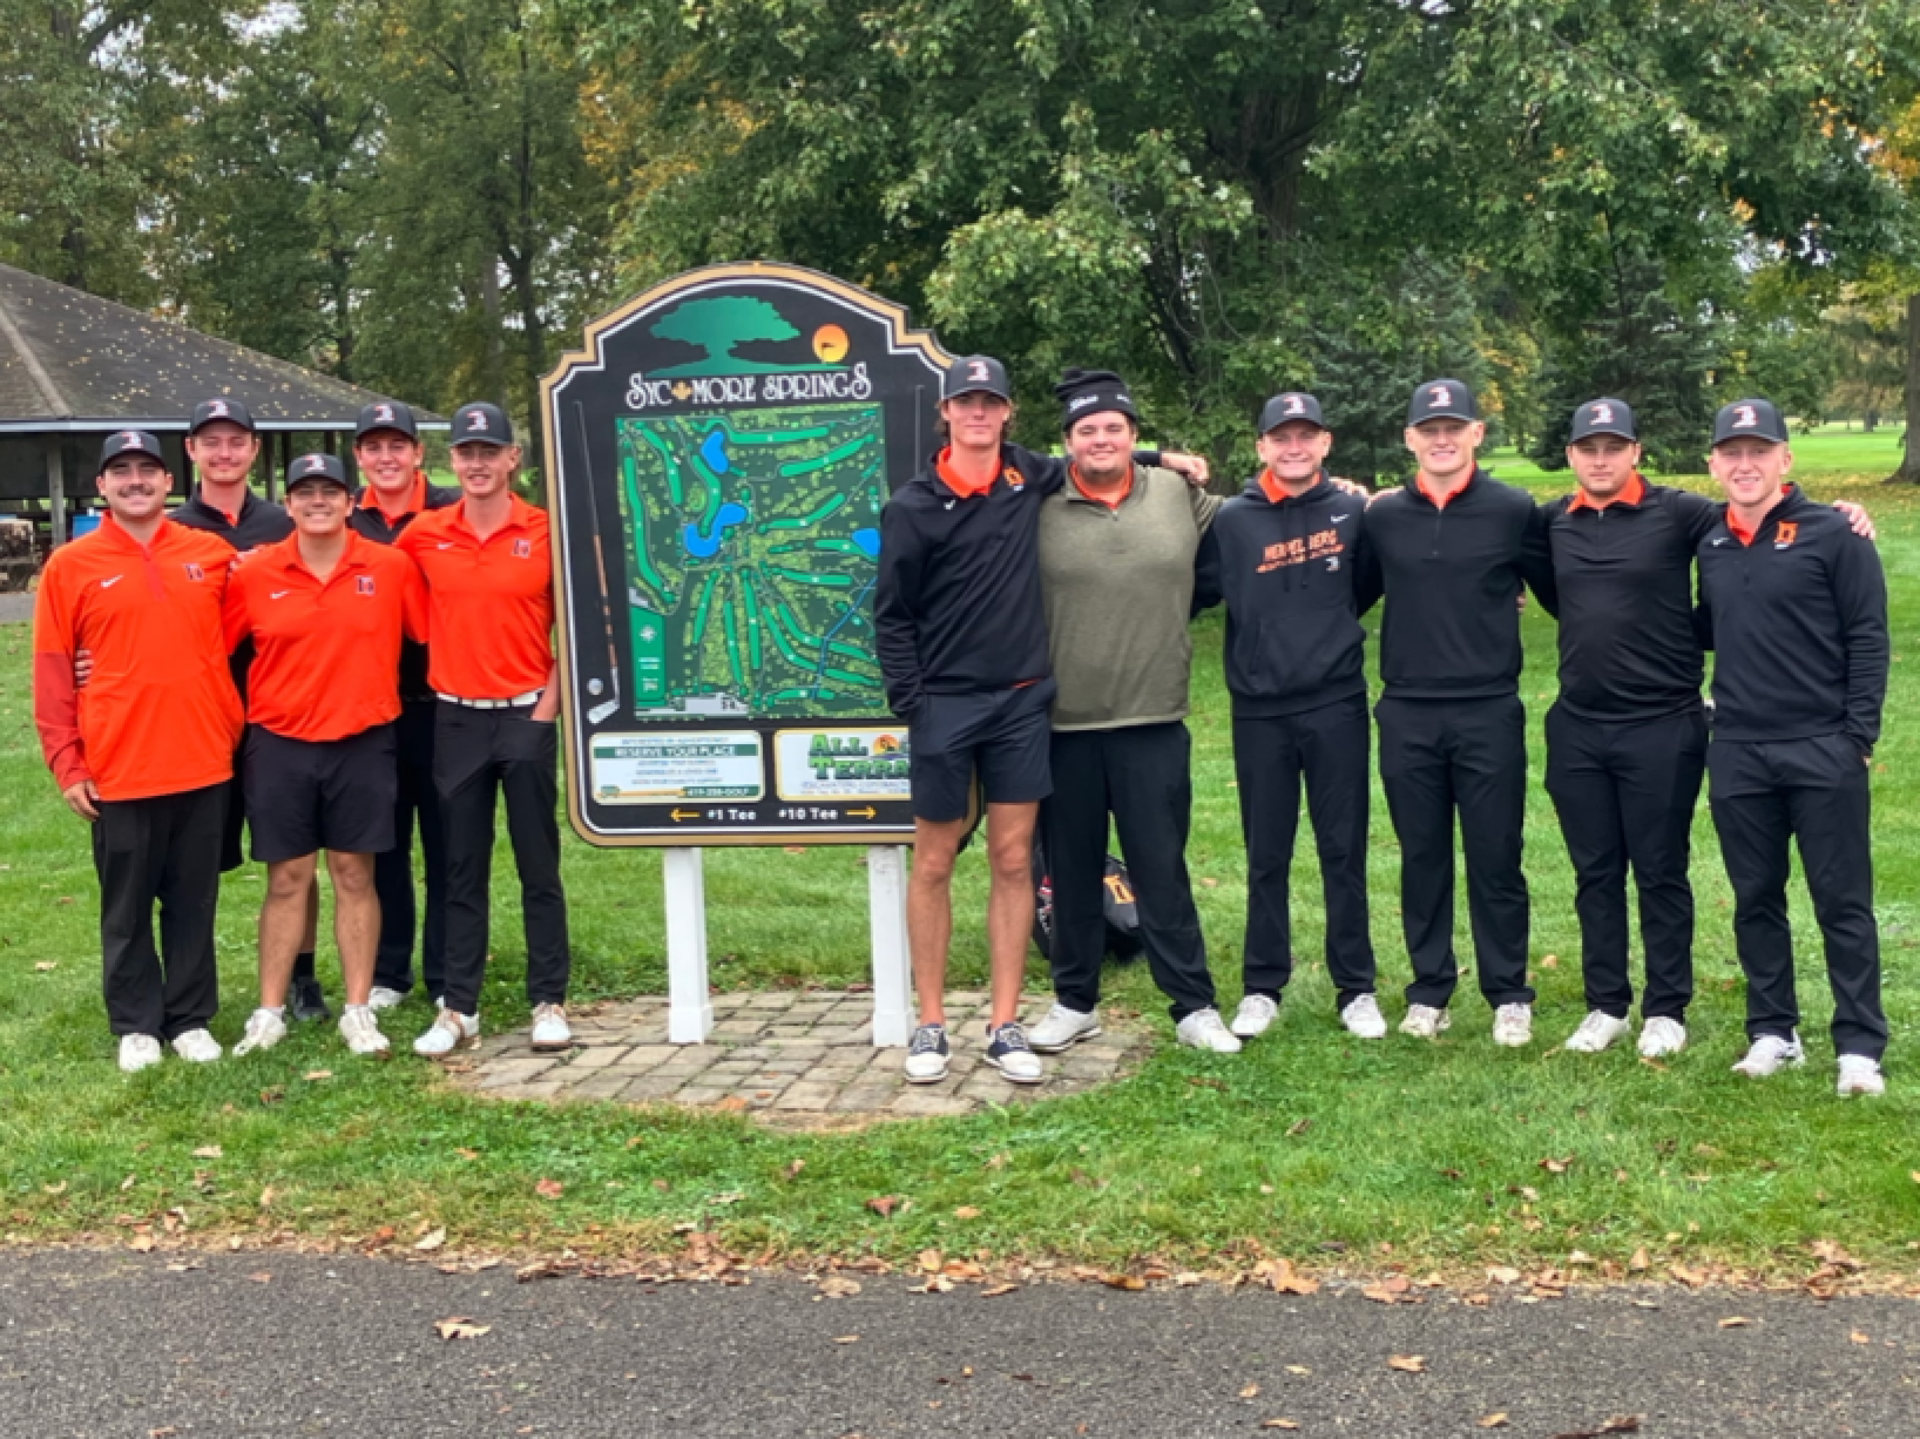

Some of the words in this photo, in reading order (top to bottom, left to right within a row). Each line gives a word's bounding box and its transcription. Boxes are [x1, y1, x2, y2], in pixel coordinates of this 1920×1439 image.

[626, 372, 756, 410] SYCMORE
[762, 361, 872, 400] SPRINGS
[808, 734, 868, 756] ALL
[728, 808, 756, 821] Tee
[810, 806, 838, 820] Tee
